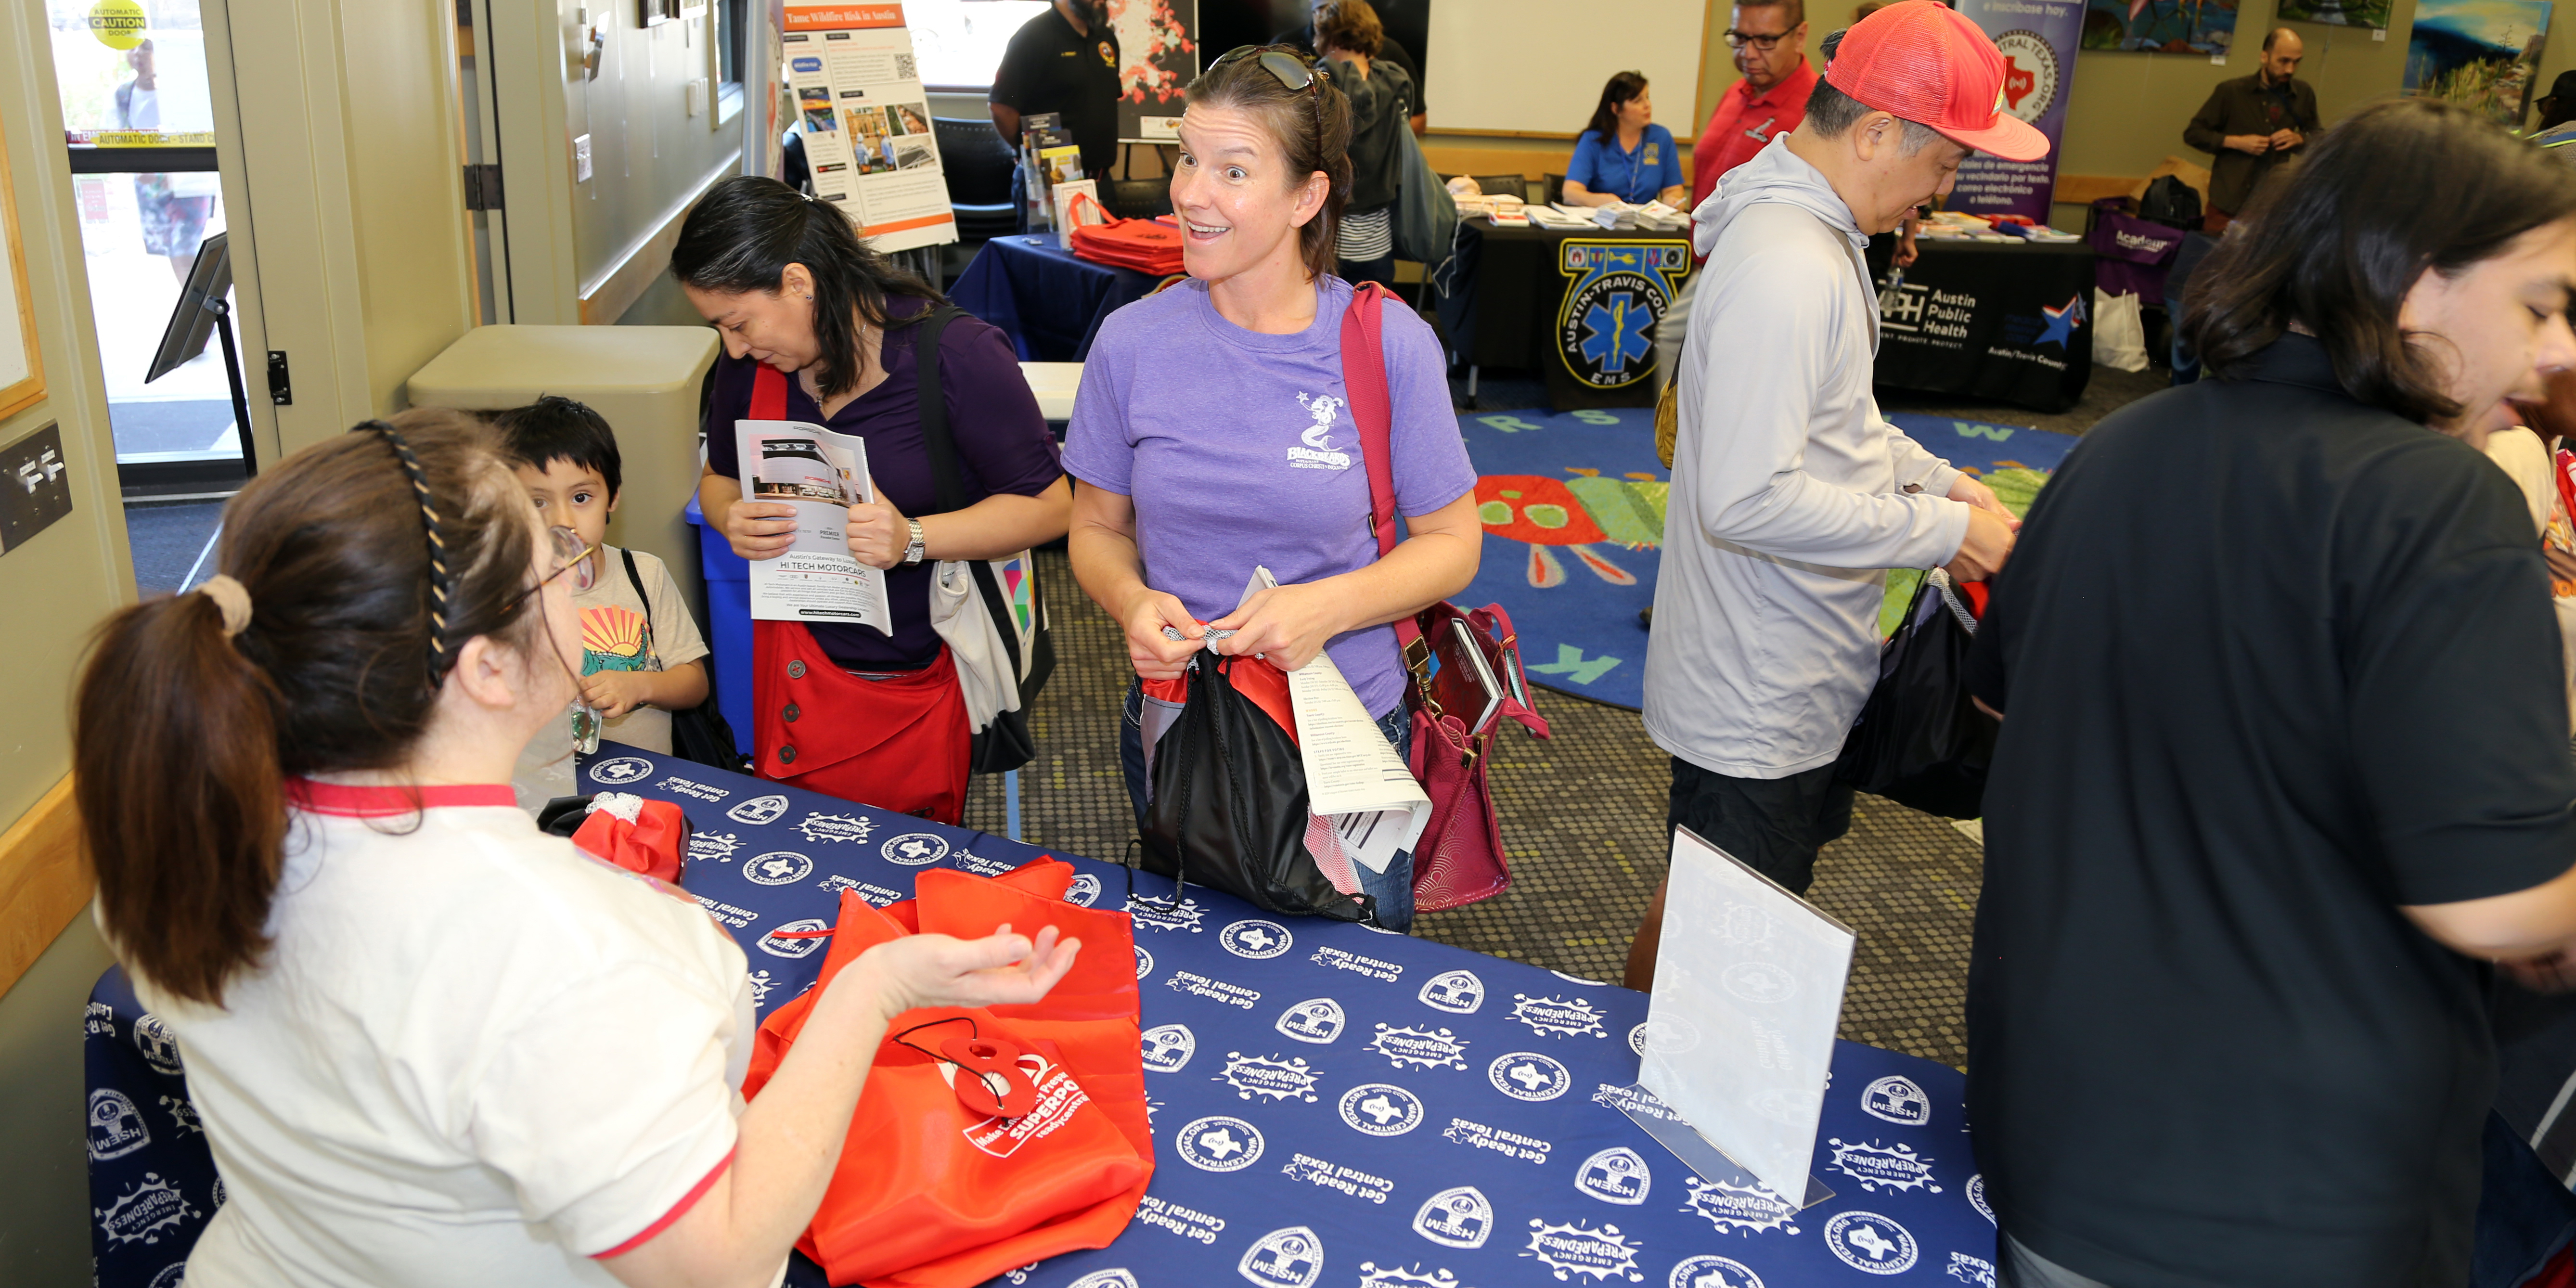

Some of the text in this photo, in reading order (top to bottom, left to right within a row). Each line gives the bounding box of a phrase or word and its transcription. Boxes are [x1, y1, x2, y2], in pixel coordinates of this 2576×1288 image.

[92, 18, 144, 27] CAUTION
[786, 9, 897, 23] Tame Wildfire Risk in Austin
[1999, 38, 2028, 50] TRAL
[100, 135, 146, 144] AUTOMATIC
[179, 135, 207, 143] STAND
[1932, 289, 1976, 308] Austin
[1567, 276, 1667, 352] AUSTIN-TRAVIS COU
[1927, 304, 1972, 323] Public
[1923, 320, 1968, 339] Health
[1591, 372, 1631, 385] EMS
[1476, 415, 1544, 433] R
[1571, 409, 1620, 425] S
[793, 426, 822, 435] PORSCHE
[805, 476, 832, 484] PORSCHE
[792, 562, 815, 570] TECH
[817, 563, 867, 578] MOTORCARS
[842, 557, 858, 566] Luxury
[1526, 643, 1622, 685] K
[667, 776, 730, 797] Central Texas
[673, 784, 721, 803] Get Ready
[735, 809, 769, 821] HSEM
[808, 820, 863, 834] PREPAREDNESS
[811, 827, 853, 836] EMERGENCY
[829, 875, 902, 901] Central Texas
[1137, 912, 1183, 923] EMERGENCY
[769, 937, 805, 953] HSEM
[1318, 945, 1404, 975] Central Texas
[1331, 958, 1398, 983] Get Ready
[1175, 970, 1262, 1002] Central Texas
[1185, 982, 1255, 1010] Get Ready
[1428, 991, 1470, 1008] HSEM
[1520, 1004, 1594, 1023] PREPAREDNESS
[1533, 1015, 1582, 1027] EMERGENCY
[1286, 1020, 1329, 1037] HSEM
[1380, 1034, 1455, 1054] PREPAREDNESS
[1391, 1047, 1443, 1058] EMERGENCY
[1232, 1063, 1308, 1085] PREPAREDNESS
[1241, 1075, 1293, 1090] EMERGENCY
[1551, 1069, 1564, 1093] WARN
[1513, 1086, 1556, 1097] CENTRAL
[1010, 1079, 1079, 1140] SUPERPO
[1404, 1102, 1417, 1126] WARN
[1871, 1100, 1918, 1119] HSEM
[975, 1124, 1005, 1148] Make
[1362, 1120, 1406, 1133] CENTRAL
[1450, 1117, 1551, 1153] Central Texas
[96, 1126, 142, 1151] HSEM
[1241, 1137, 1257, 1160] WARN
[1468, 1132, 1547, 1165] Get Ready
[1198, 1154, 1246, 1168] CENTRAL
[1838, 1152, 1924, 1174] PREPAREDNESS
[1291, 1152, 1394, 1193] Central Texas
[1856, 1167, 1911, 1180] EMERGENCY
[1306, 1170, 1387, 1205] Get Ready
[1587, 1176, 1635, 1198] HSEM
[108, 1191, 180, 1231] PREPAREDNESS
[1694, 1192, 1782, 1214] PREPAREDNESS
[131, 1205, 177, 1232] EMERGENCY
[1136, 1206, 1217, 1246] Get Ready
[1424, 1217, 1476, 1240] HSEM
[1537, 1236, 1626, 1261] PREPAREDNESS
[1552, 1251, 1612, 1266] EMERGENCY
[1252, 1258, 1303, 1284] HSEM
